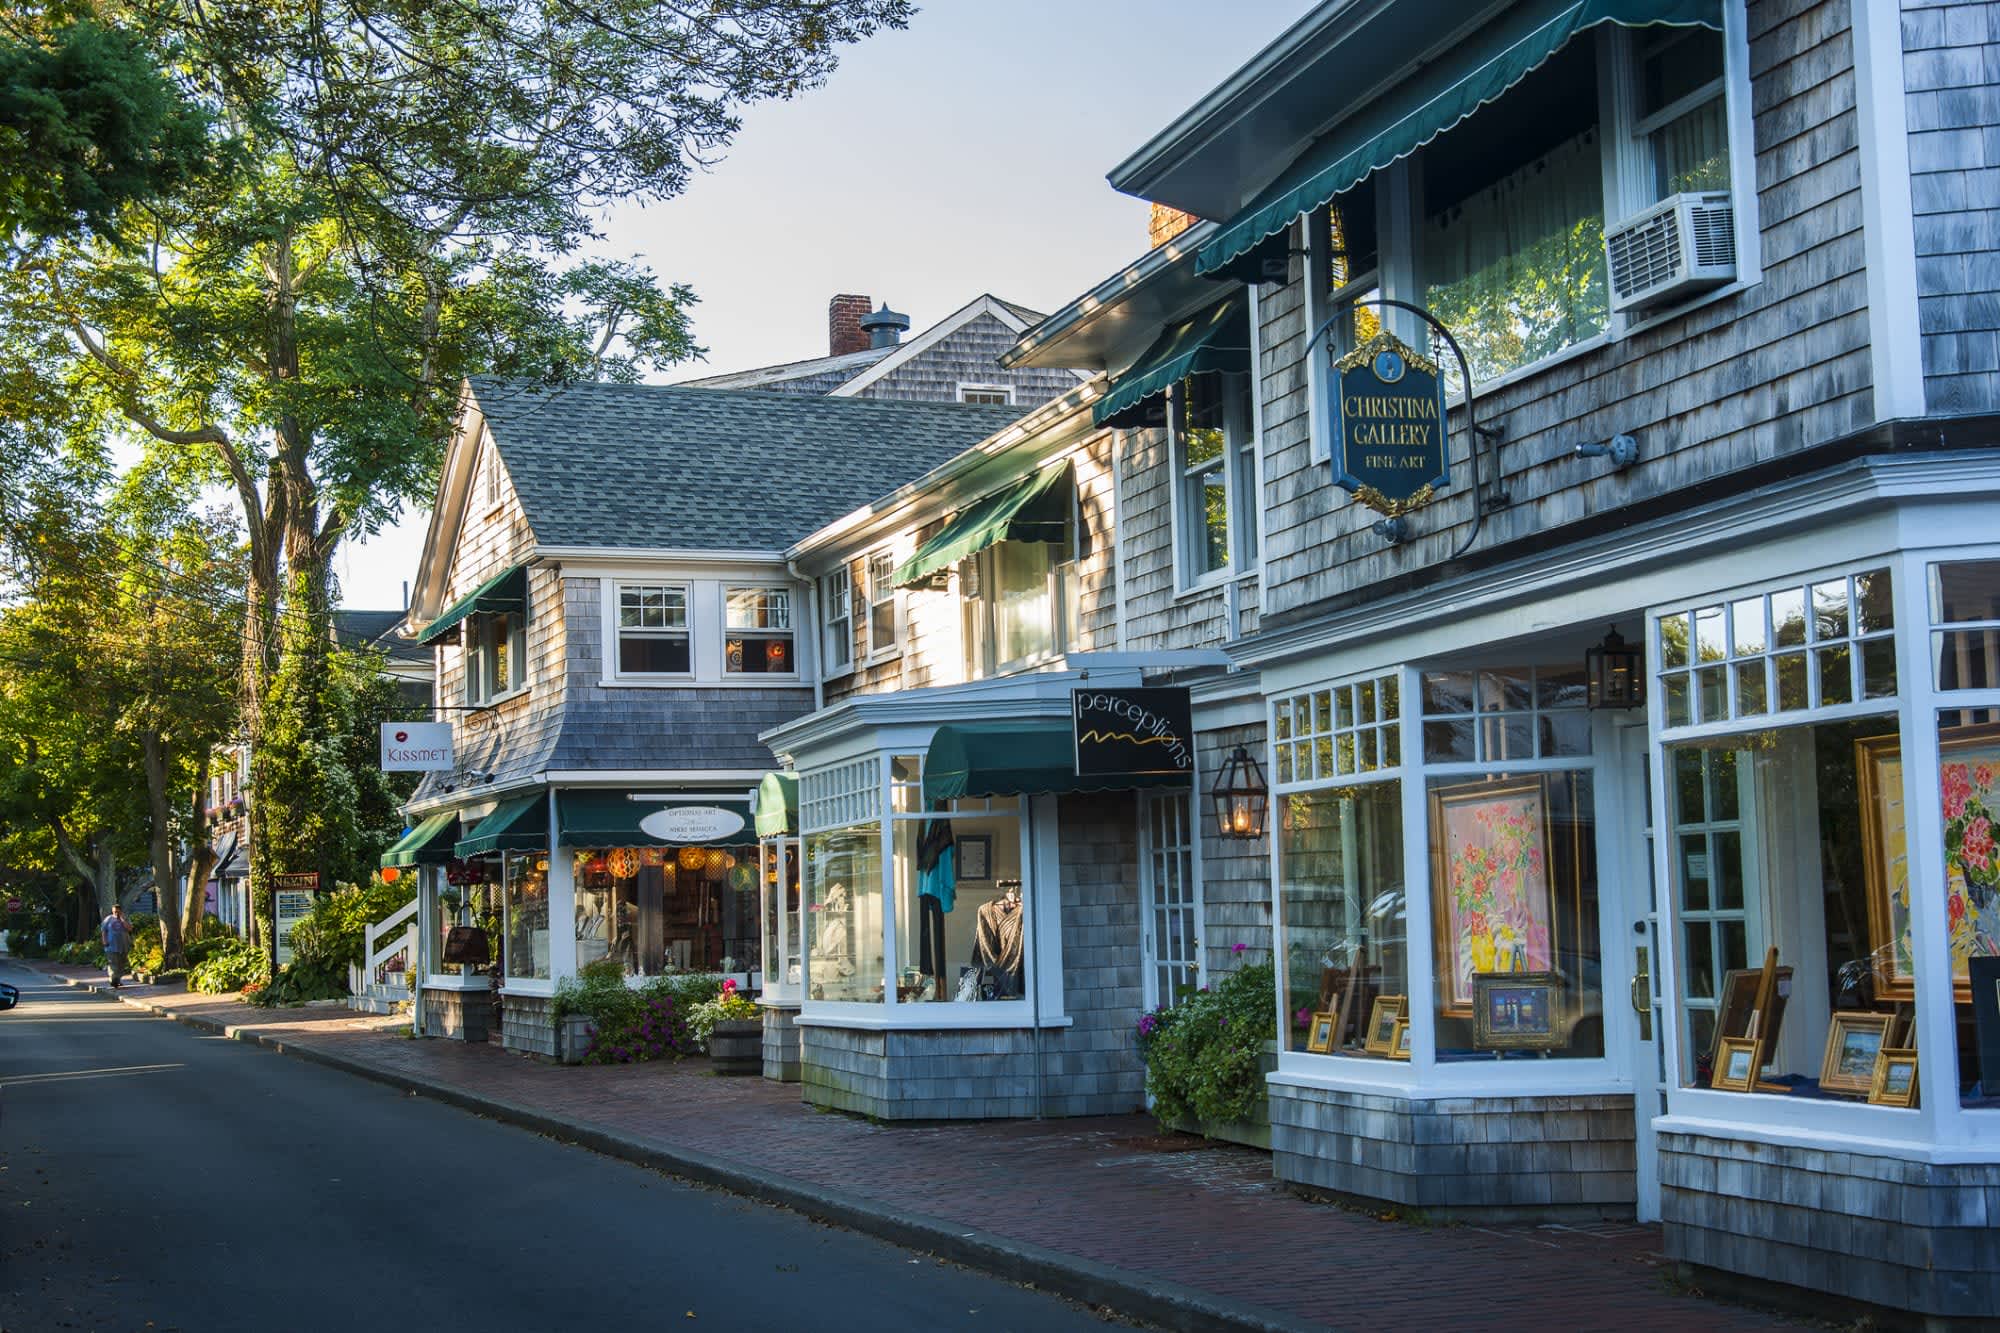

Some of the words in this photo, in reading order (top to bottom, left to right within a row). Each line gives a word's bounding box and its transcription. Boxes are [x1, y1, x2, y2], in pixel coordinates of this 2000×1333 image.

[1345, 396, 1437, 418] CHRISTINA
[1353, 423, 1430, 445] GALLERY
[1365, 455, 1396, 468] FINE
[1399, 455, 1426, 468] ART
[1077, 692, 1192, 768] perceptions
[387, 748, 448, 762] KISSMET
